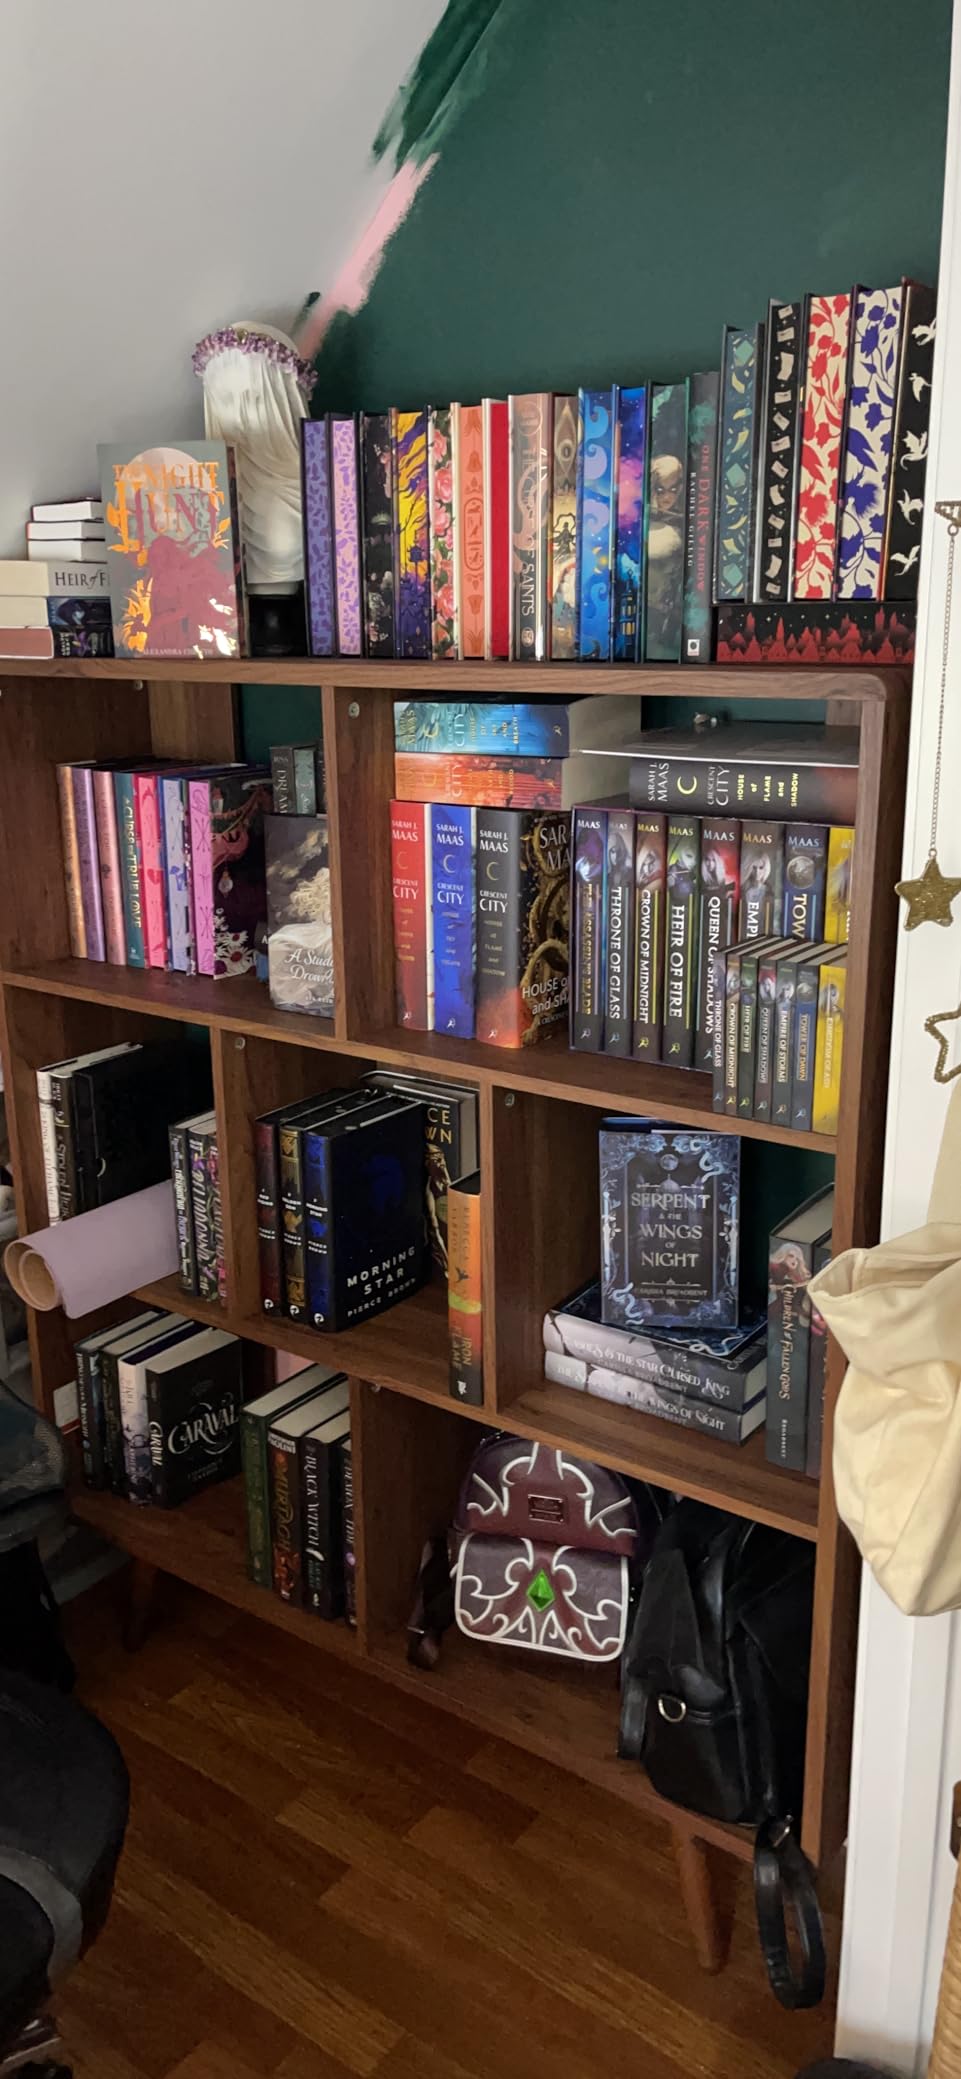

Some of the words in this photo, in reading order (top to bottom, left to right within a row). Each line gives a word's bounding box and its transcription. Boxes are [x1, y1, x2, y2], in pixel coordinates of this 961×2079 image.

[688, 472, 697, 518] RACHEL
[697, 479, 710, 530] DARK
[54, 571, 89, 587] HEIR
[521, 563, 535, 616] SAINTS
[453, 712, 465, 747] CITY
[451, 761, 463, 797] CITY
[648, 770, 658, 802] SARAH
[657, 762, 670, 802] MAAS
[715, 765, 731, 807] CITY
[737, 774, 745, 801] HOUSE
[763, 775, 772, 802] FLAME
[777, 781, 785, 798] and
[790, 772, 799, 808] SHADOW
[391, 819, 412, 829] SARAH
[391, 829, 419, 843] MAAS
[436, 823, 459, 834] SARAH
[479, 829, 503, 839] SARAH
[576, 819, 600, 829] MAAS
[637, 823, 660, 832] MAAS
[669, 826, 694, 836] MAAS
[703, 829, 735, 841] MAAS
[436, 833, 465, 847] MAAS
[479, 839, 509, 853] MAAS
[743, 832, 773, 844] MAAS
[788, 836, 820, 847] MAAS
[392, 886, 419, 900] CITY
[437, 890, 465, 905] CITY
[479, 889, 508, 899] CRESCENT
[479, 898, 509, 913] CITY
[610, 886, 622, 950] THRONE
[640, 889, 651, 939] CROWN
[671, 905, 685, 948] HEIR
[707, 896, 721, 945] QUEEN
[285, 948, 303, 963] A
[609, 952, 621, 973] OF
[640, 940, 650, 961] OF
[670, 952, 684, 977] OF
[521, 978, 559, 999] HOUSE
[609, 975, 621, 1020] GLASS
[639, 962, 650, 1024] MIDNIGHT
[669, 980, 684, 1018] FIRE
[531, 1000, 551, 1015] and
[714, 1000, 722, 1033] THRONE
[714, 1033, 722, 1044] OF
[713, 1044, 722, 1068] GLASS
[727, 1046, 736, 1088] MIDNIGHT
[631, 1191, 711, 1211] SERPENT
[639, 1223, 703, 1240] WINGS
[346, 1245, 416, 1288] MORNING
[641, 1252, 700, 1268] NIGHT
[363, 1267, 405, 1296] STAR
[347, 1296, 382, 1318] PIERCE
[781, 1282, 798, 1334] CHILDREN
[461, 1336, 473, 1366] IRON
[780, 1339, 794, 1373] FALLEN
[616, 1353, 634, 1365] THE
[635, 1357, 660, 1374] STAR
[659, 1364, 701, 1387] CURSED
[699, 1377, 731, 1399] KING
[168, 1403, 240, 1455] CARAVAL
[303, 1453, 318, 1498] BLACK
[306, 1503, 320, 1548] WITCH
